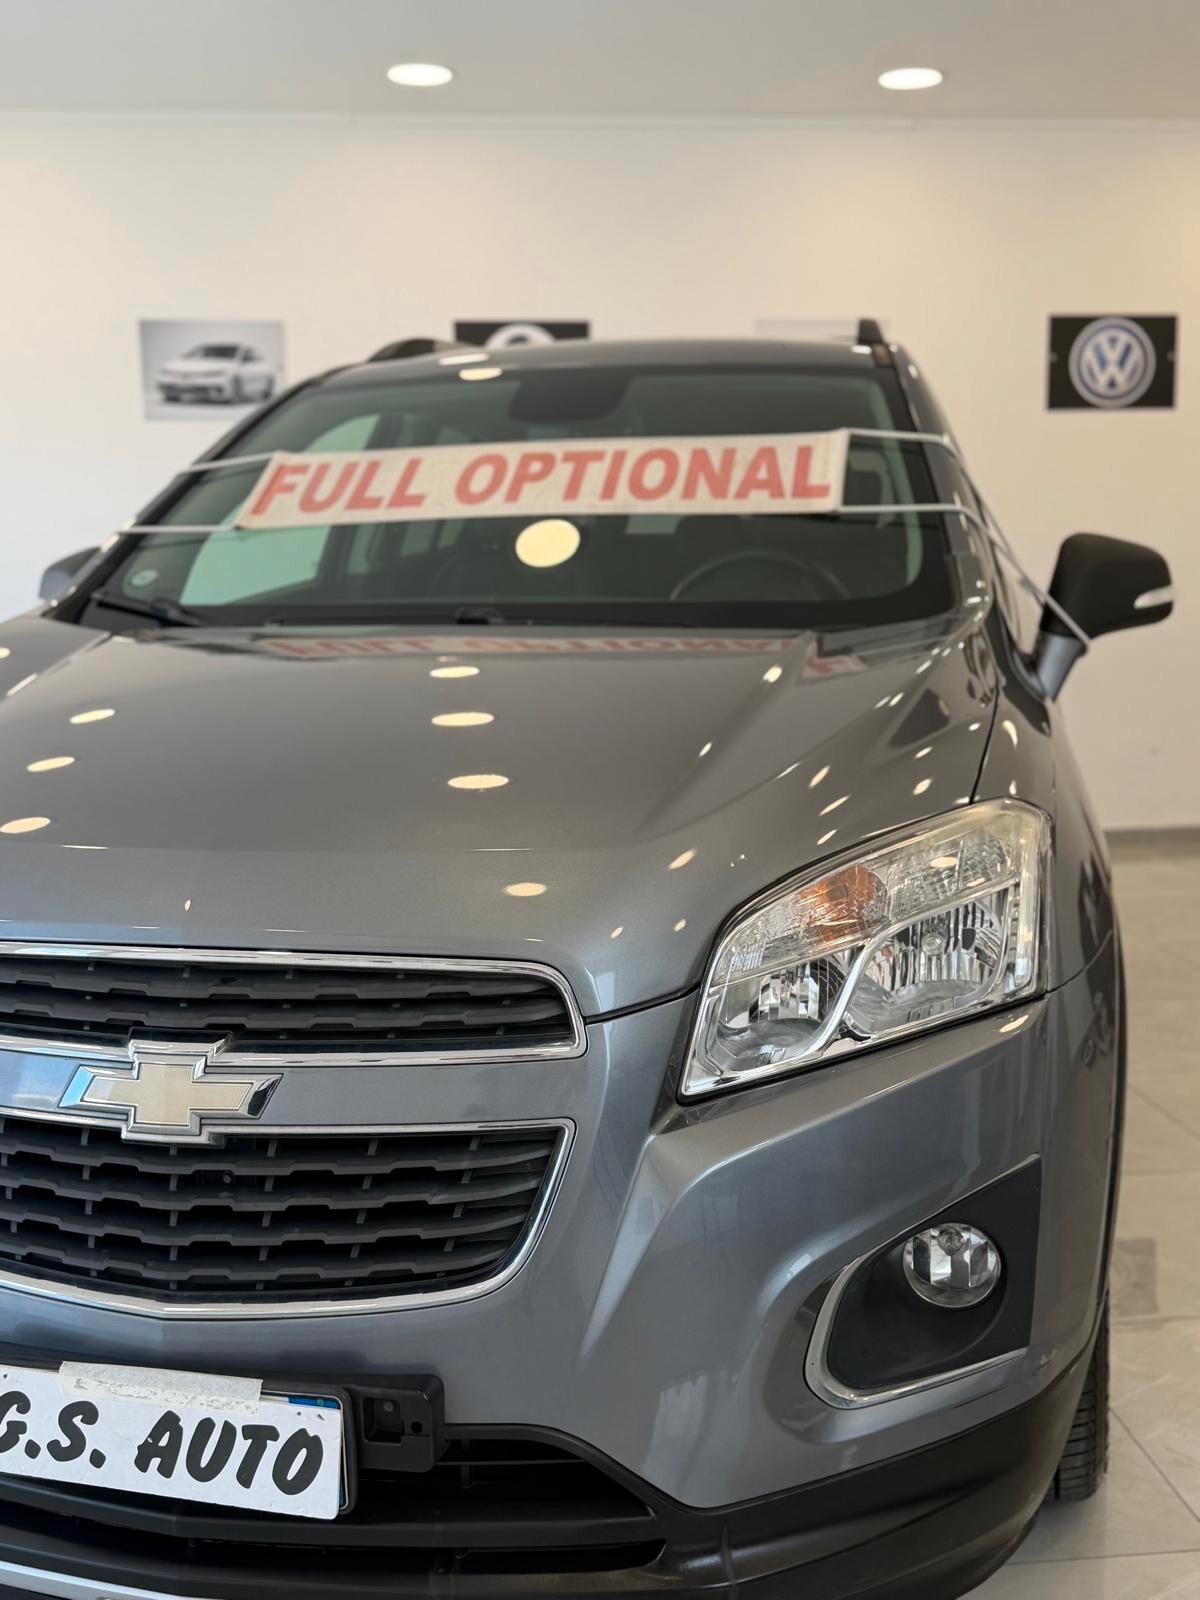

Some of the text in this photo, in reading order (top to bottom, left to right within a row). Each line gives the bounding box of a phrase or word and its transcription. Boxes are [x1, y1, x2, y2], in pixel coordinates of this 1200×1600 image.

[250, 445, 831, 515] FULL OPTIONAL
[134, 1410, 324, 1495] AUTO
